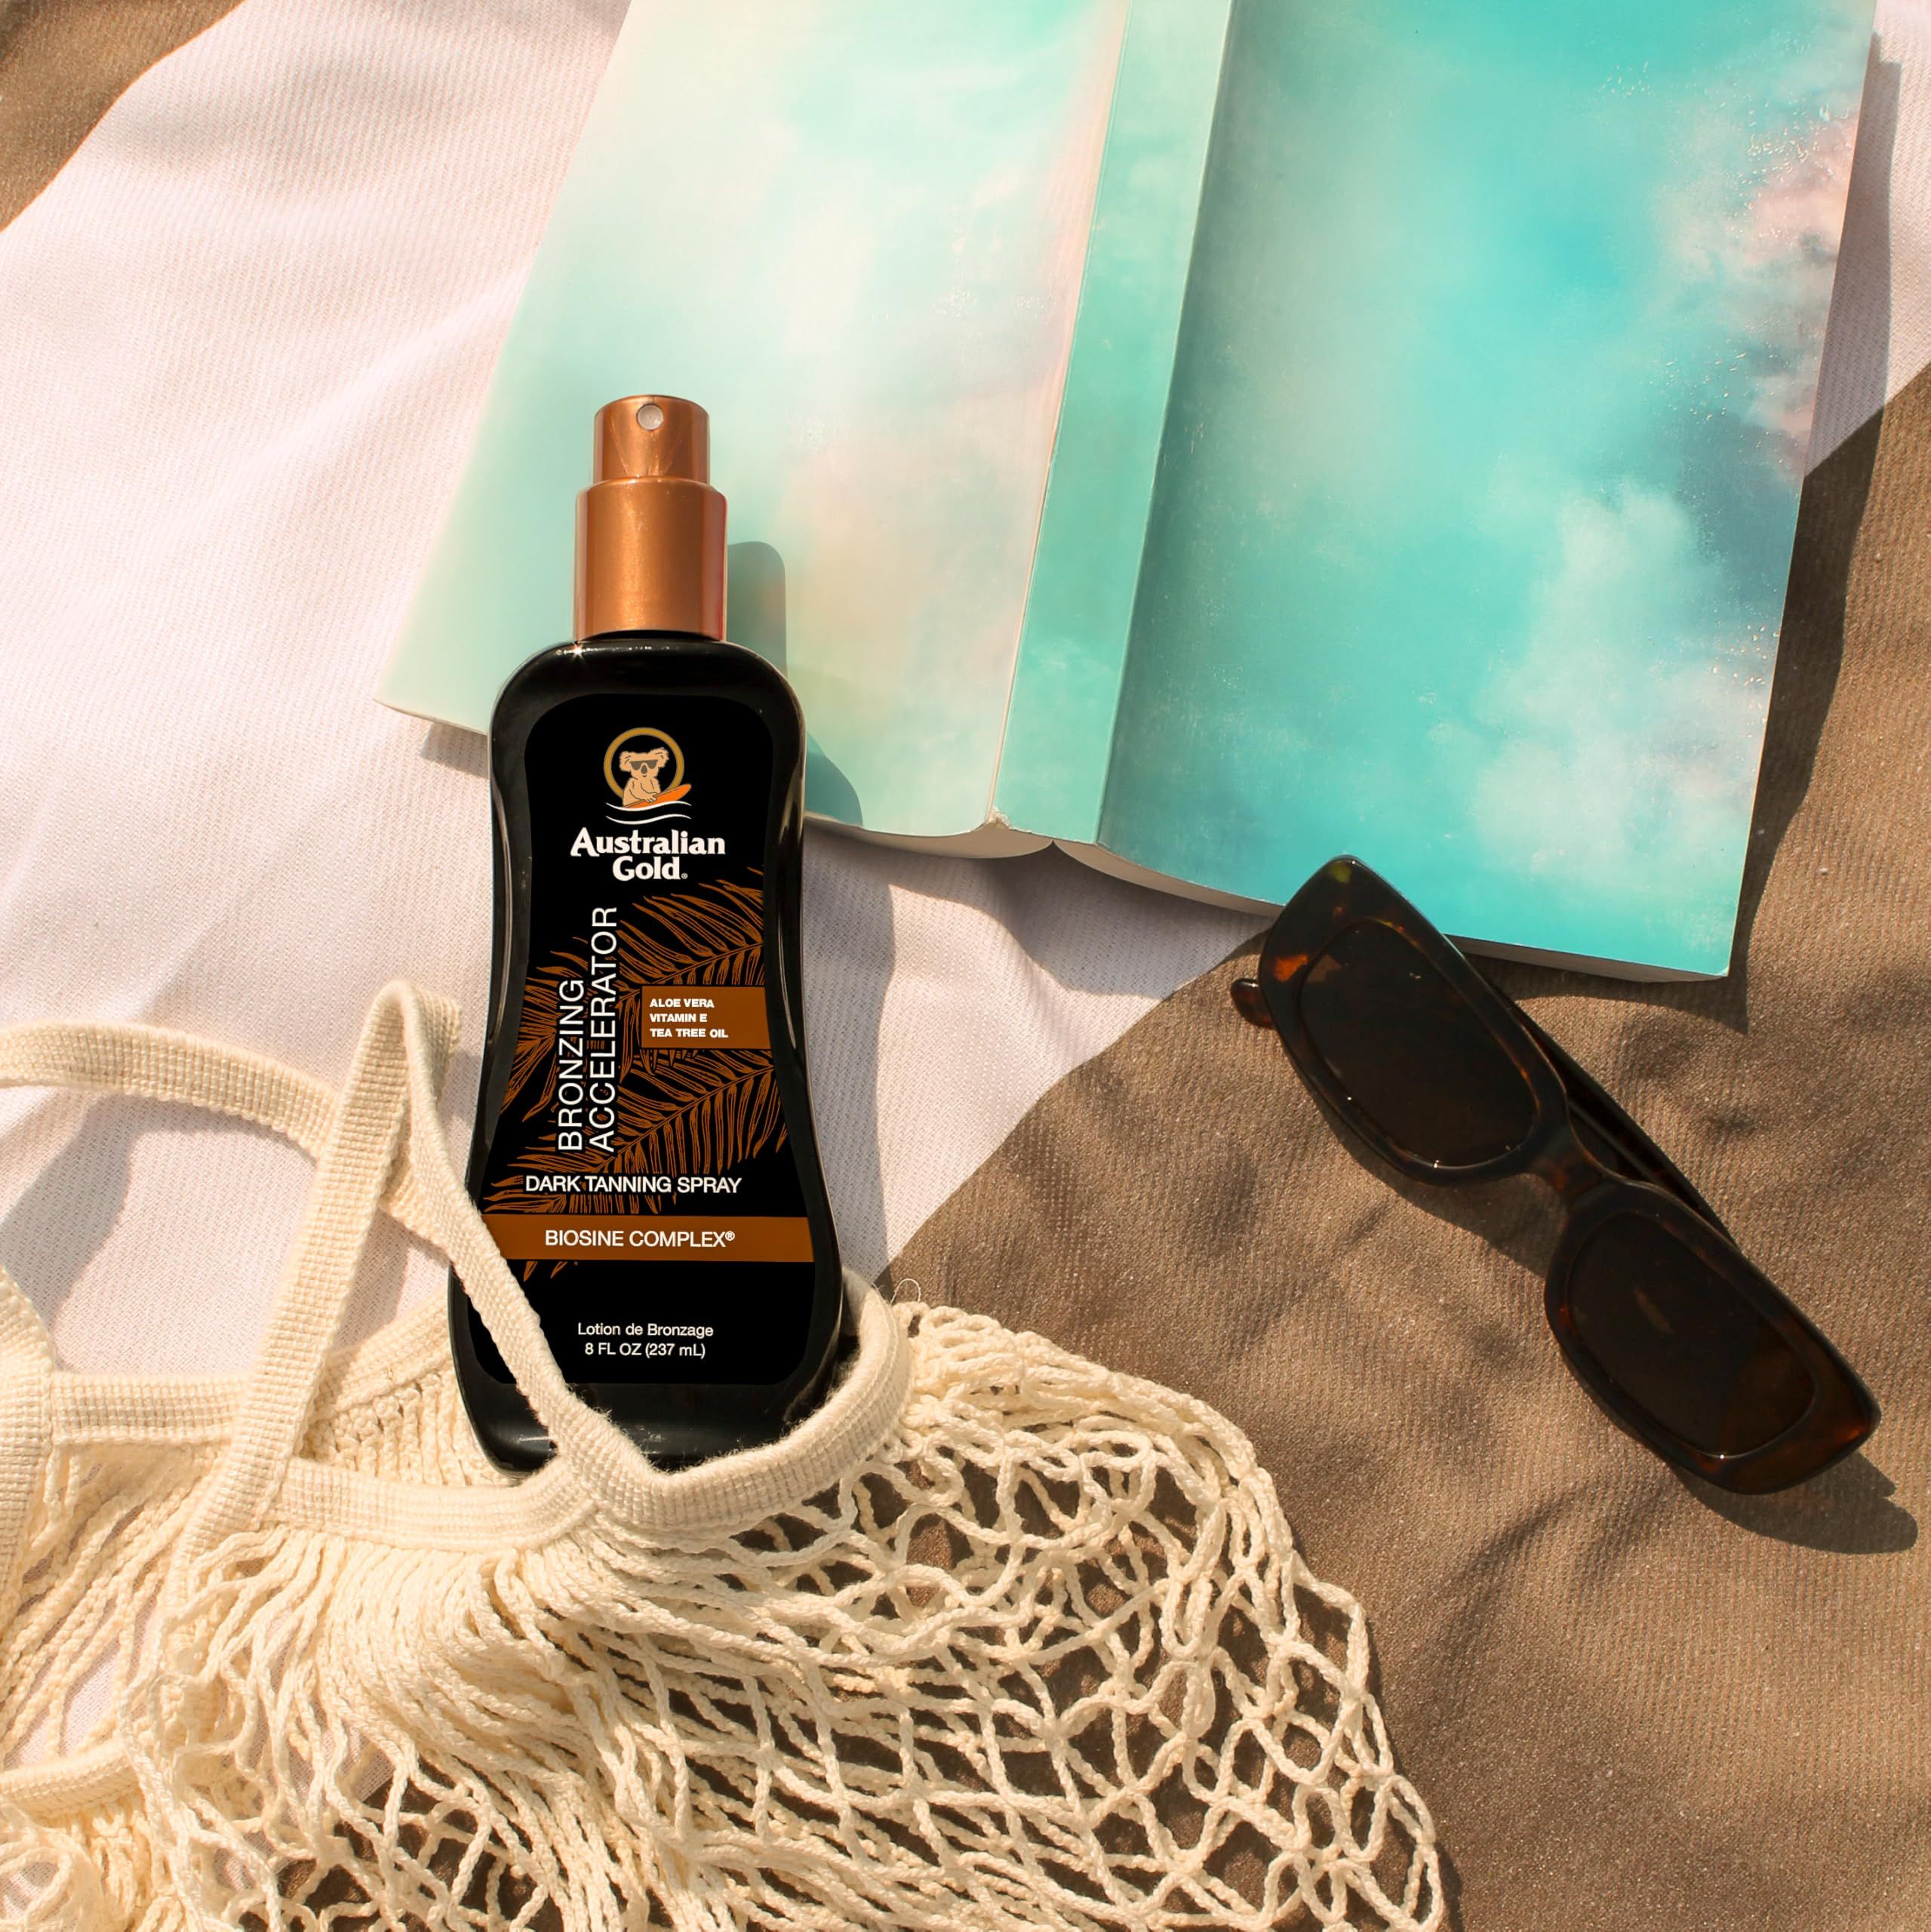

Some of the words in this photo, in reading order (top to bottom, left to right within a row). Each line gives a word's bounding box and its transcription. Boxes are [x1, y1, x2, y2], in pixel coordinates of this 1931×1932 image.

[570, 826, 726, 857] Australian
[649, 998, 681, 1008] ALOE
[683, 998, 715, 1009] VERA
[649, 1013, 696, 1023] VITAMIN
[699, 1013, 708, 1023] E
[589, 907, 617, 1153] ACCELERATOR
[649, 1028, 673, 1038] TEA
[675, 1028, 706, 1038] TREE
[709, 1029, 729, 1039] OIL
[558, 980, 585, 1151] BRONZING
[525, 1175, 581, 1194] DARK
[584, 1176, 672, 1194] TANNING
[677, 1177, 743, 1195] SPRAY
[545, 1229, 624, 1247] BIOSINE
[577, 1322, 621, 1337] Lotion
[625, 1322, 644, 1337] de
[647, 1323, 714, 1340] Bronzage
[584, 1343, 594, 1356] 8
[598, 1343, 617, 1356] FL
[619, 1343, 642, 1356] OZ
[644, 1343, 675, 1359] (237
[679, 1343, 706, 1359] mL)
